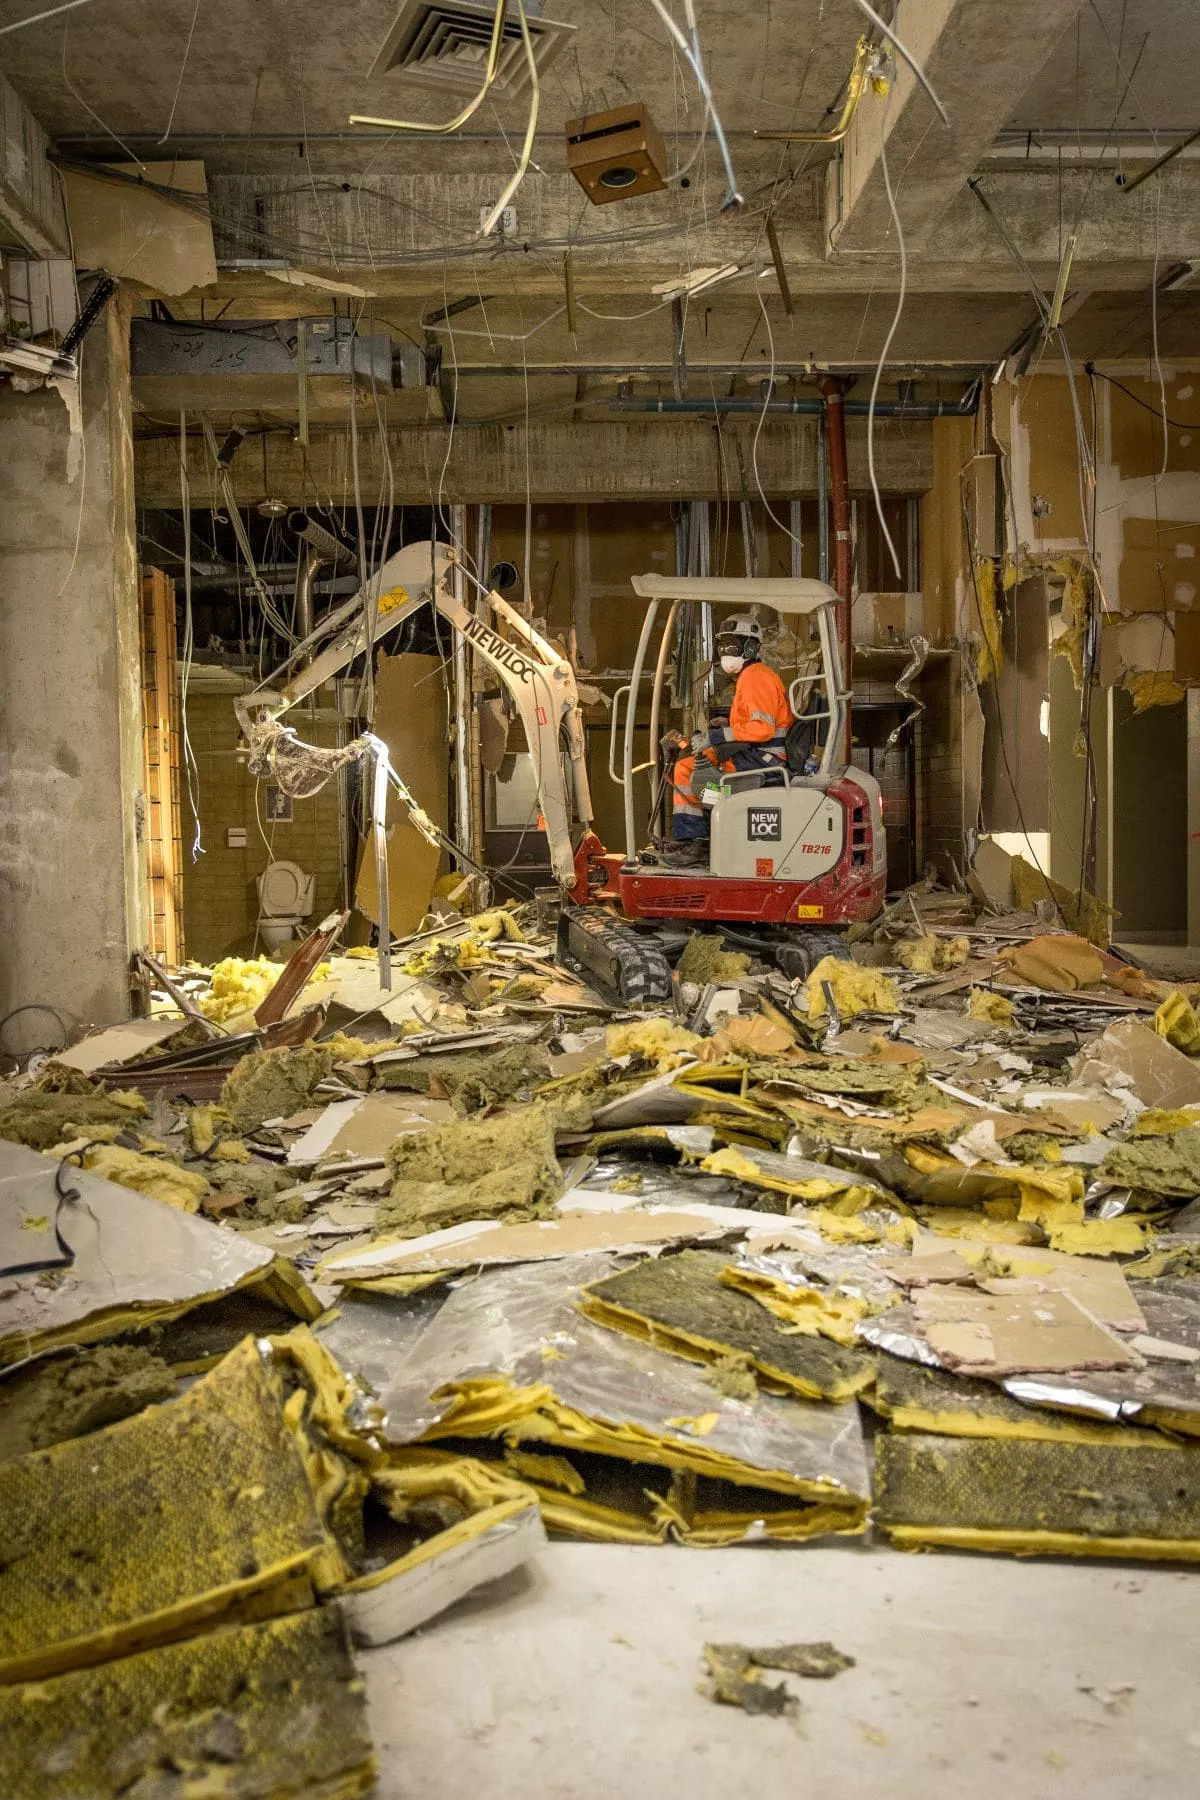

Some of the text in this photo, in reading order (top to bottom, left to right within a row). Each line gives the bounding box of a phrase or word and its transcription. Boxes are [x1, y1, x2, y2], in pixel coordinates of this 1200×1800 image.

[463, 619, 536, 684] NEWLOC
[751, 813, 778, 823] NEW
[751, 823, 778, 836] LOC
[801, 844, 832, 855] TB216
